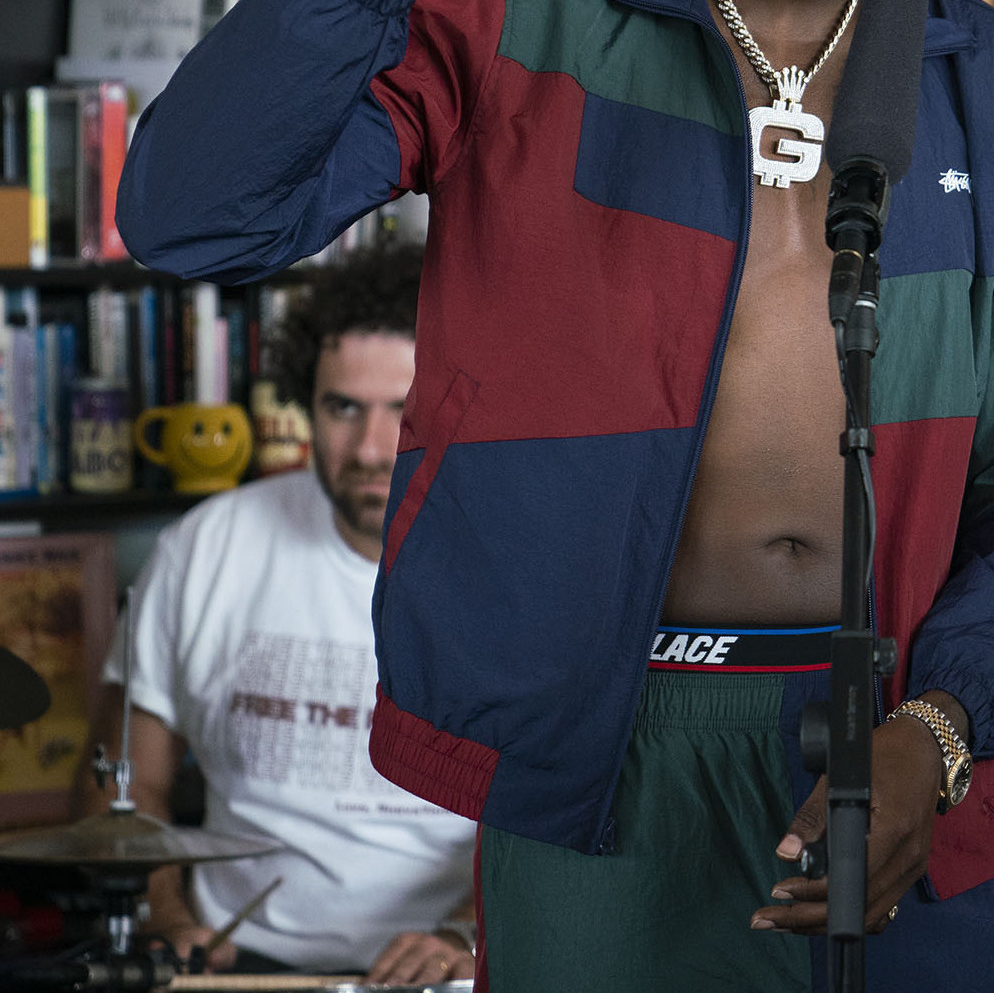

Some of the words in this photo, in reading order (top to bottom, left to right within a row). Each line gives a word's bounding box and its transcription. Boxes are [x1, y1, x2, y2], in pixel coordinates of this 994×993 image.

[649, 633, 739, 664] LACE
[230, 689, 297, 723] FREE
[305, 701, 358, 729] THE
